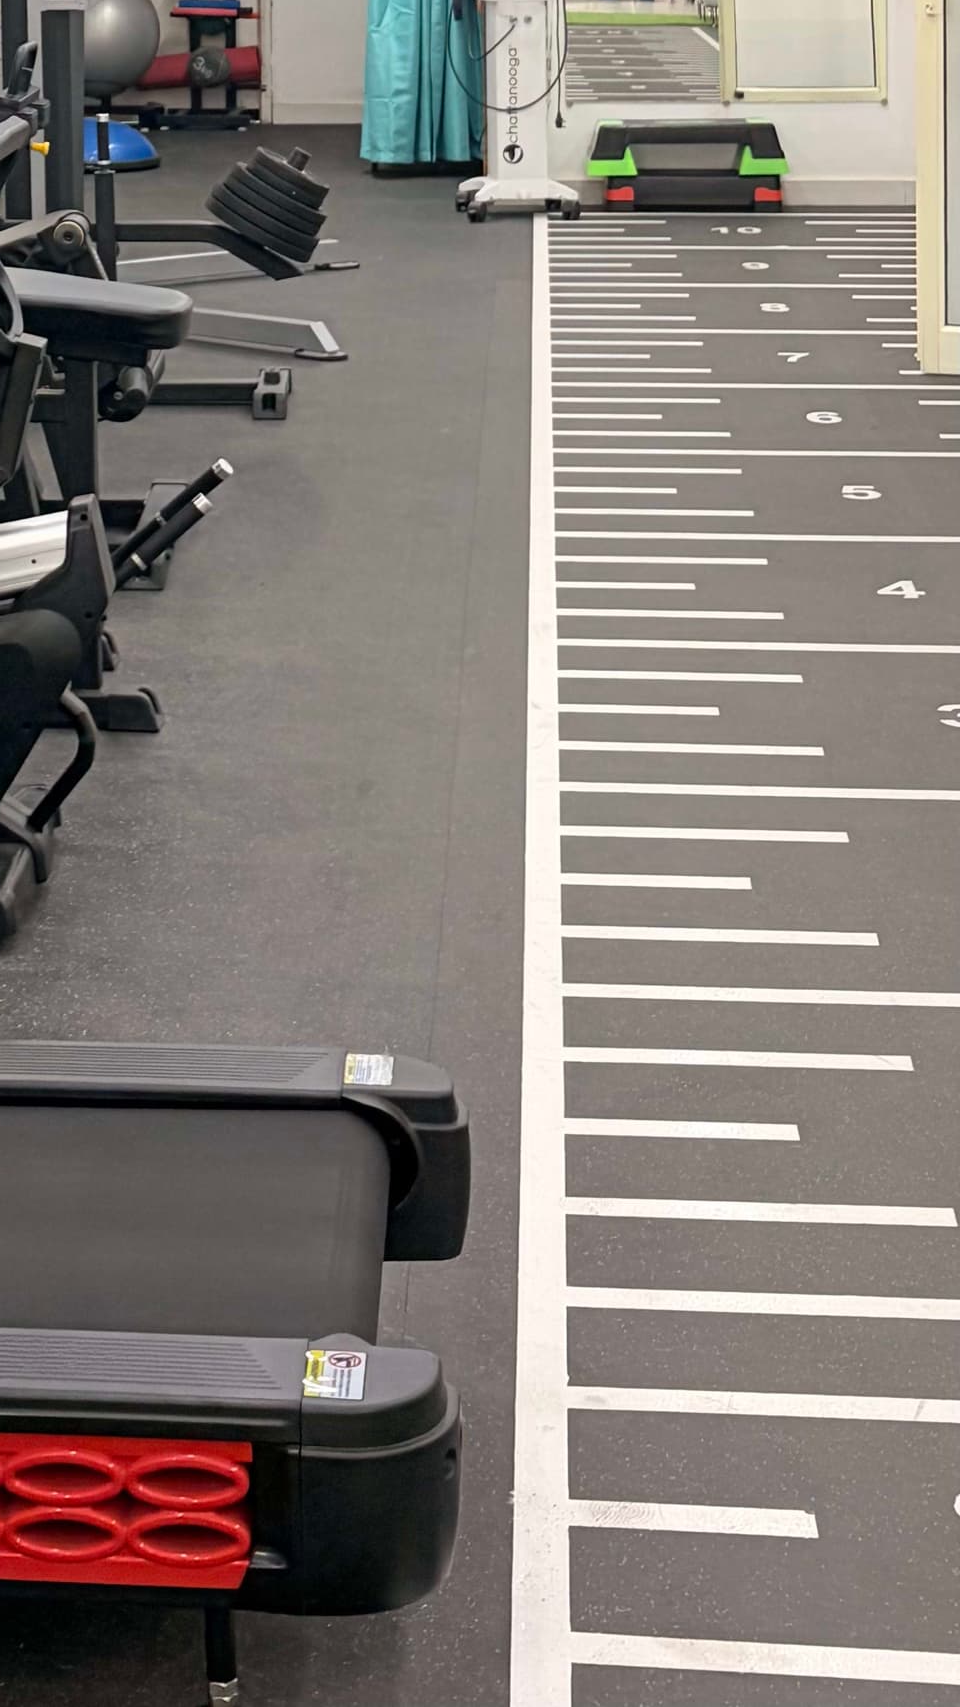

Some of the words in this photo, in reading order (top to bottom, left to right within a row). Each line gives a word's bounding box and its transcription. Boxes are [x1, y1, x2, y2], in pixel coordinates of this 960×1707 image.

[711, 226, 762, 235] 10
[777, 351, 810, 363] 7
[806, 410, 843, 424] 6
[841, 485, 882, 500] 5
[876, 579, 926, 599] 4
